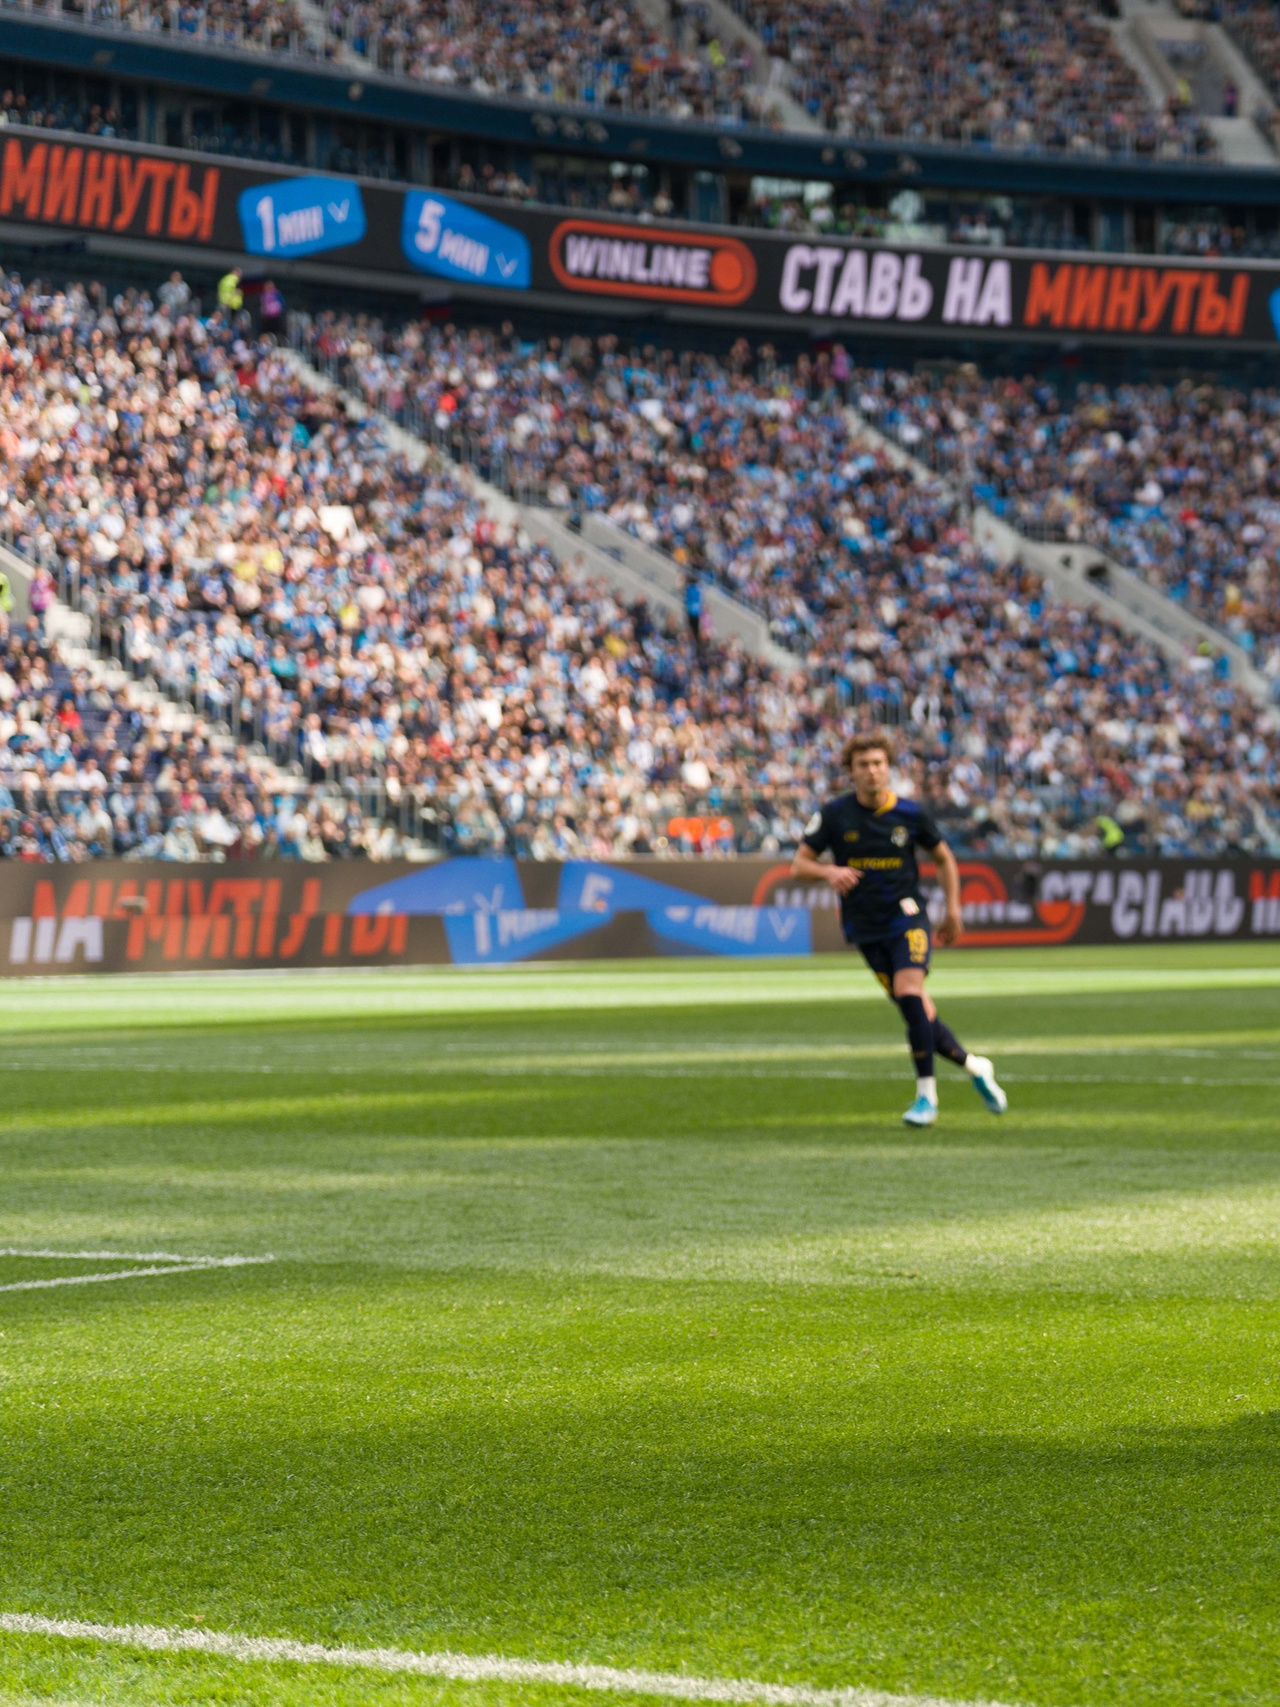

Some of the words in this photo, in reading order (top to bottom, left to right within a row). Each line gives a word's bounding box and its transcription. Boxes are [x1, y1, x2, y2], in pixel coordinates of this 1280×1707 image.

[0, 138, 220, 242] МИНУТЫ
[255, 196, 277, 252] 1
[415, 199, 446, 253] 5
[565, 234, 712, 290] WINLINE
[779, 244, 933, 322] СТАВЬ
[942, 256, 1012, 326] НА
[1022, 262, 1250, 336] МИНУТЫ
